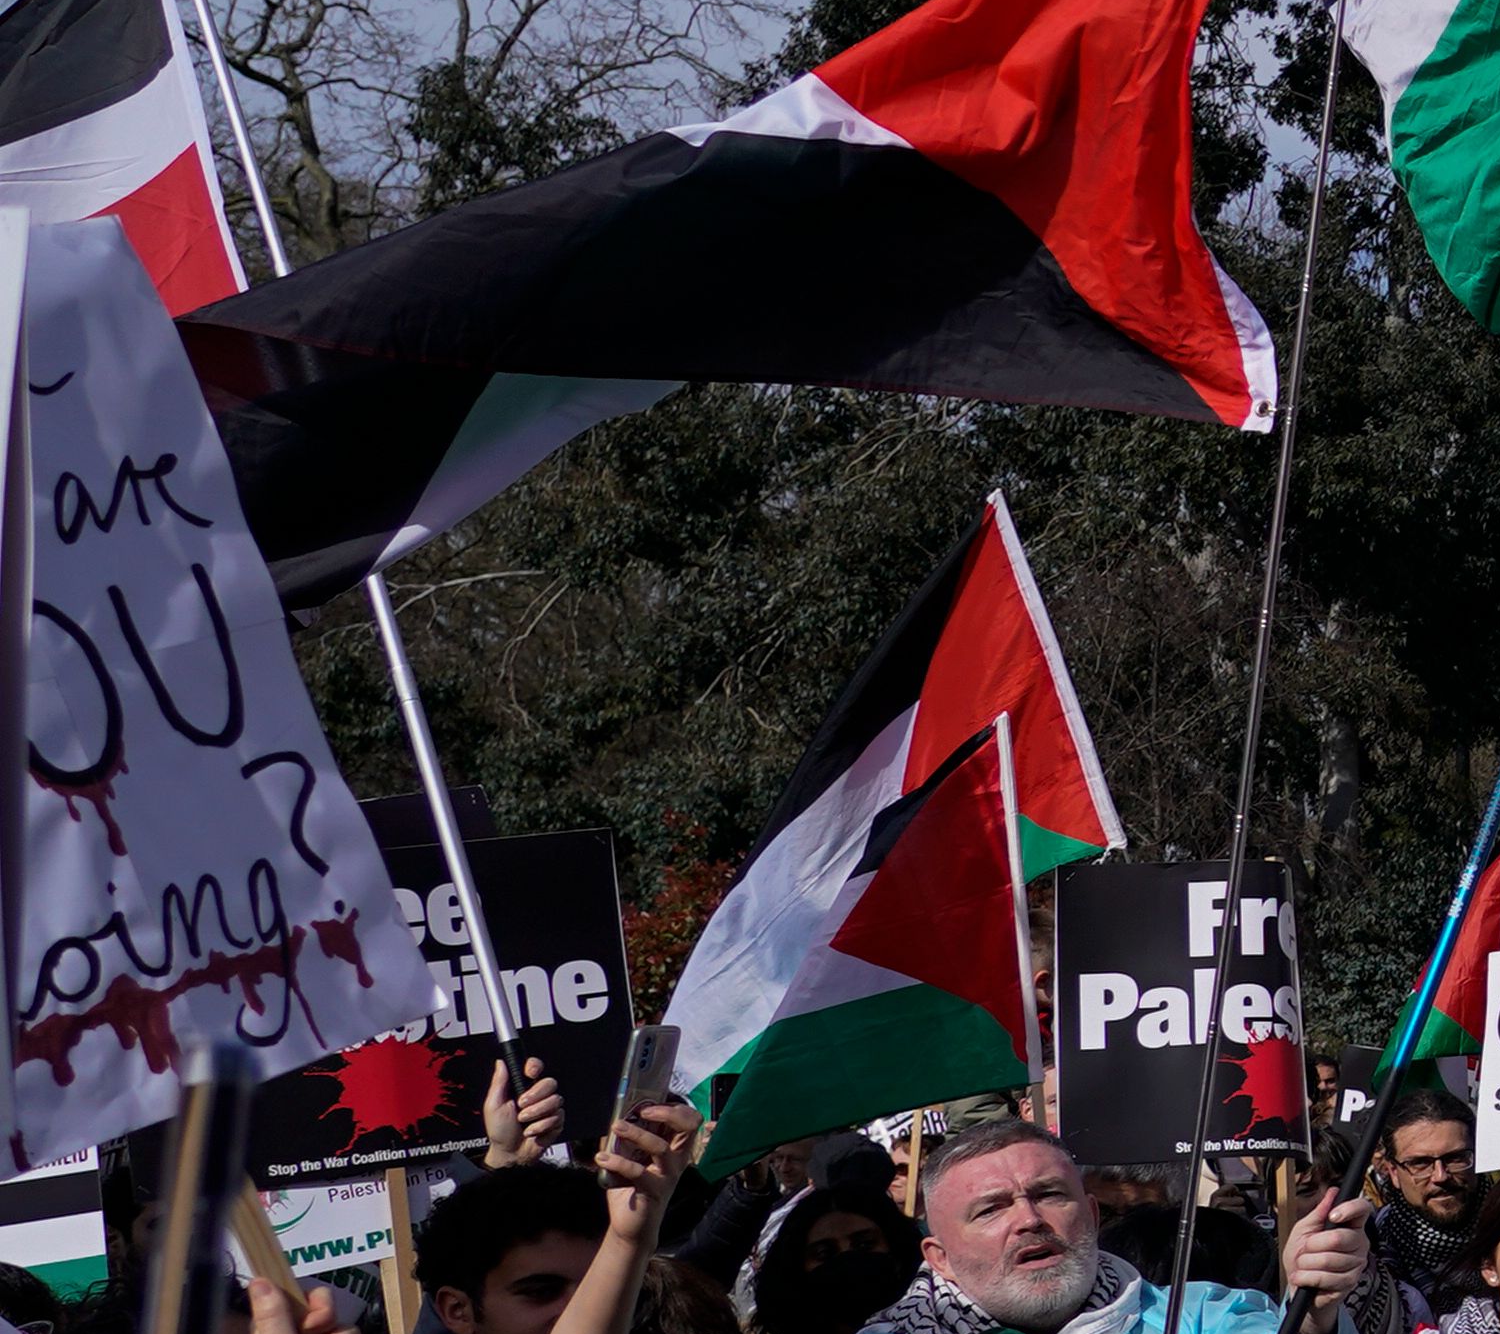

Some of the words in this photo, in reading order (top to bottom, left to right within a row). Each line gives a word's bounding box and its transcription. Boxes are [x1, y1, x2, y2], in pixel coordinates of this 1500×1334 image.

[54, 450, 213, 544] are
[268, 1163, 298, 1178] Stop
[300, 1158, 321, 1172] the
[323, 1156, 349, 1170] War
[352, 1148, 407, 1166] Coalition
[409, 1136, 490, 1157] www.stopwar.
[1223, 1140, 1244, 1151] War
